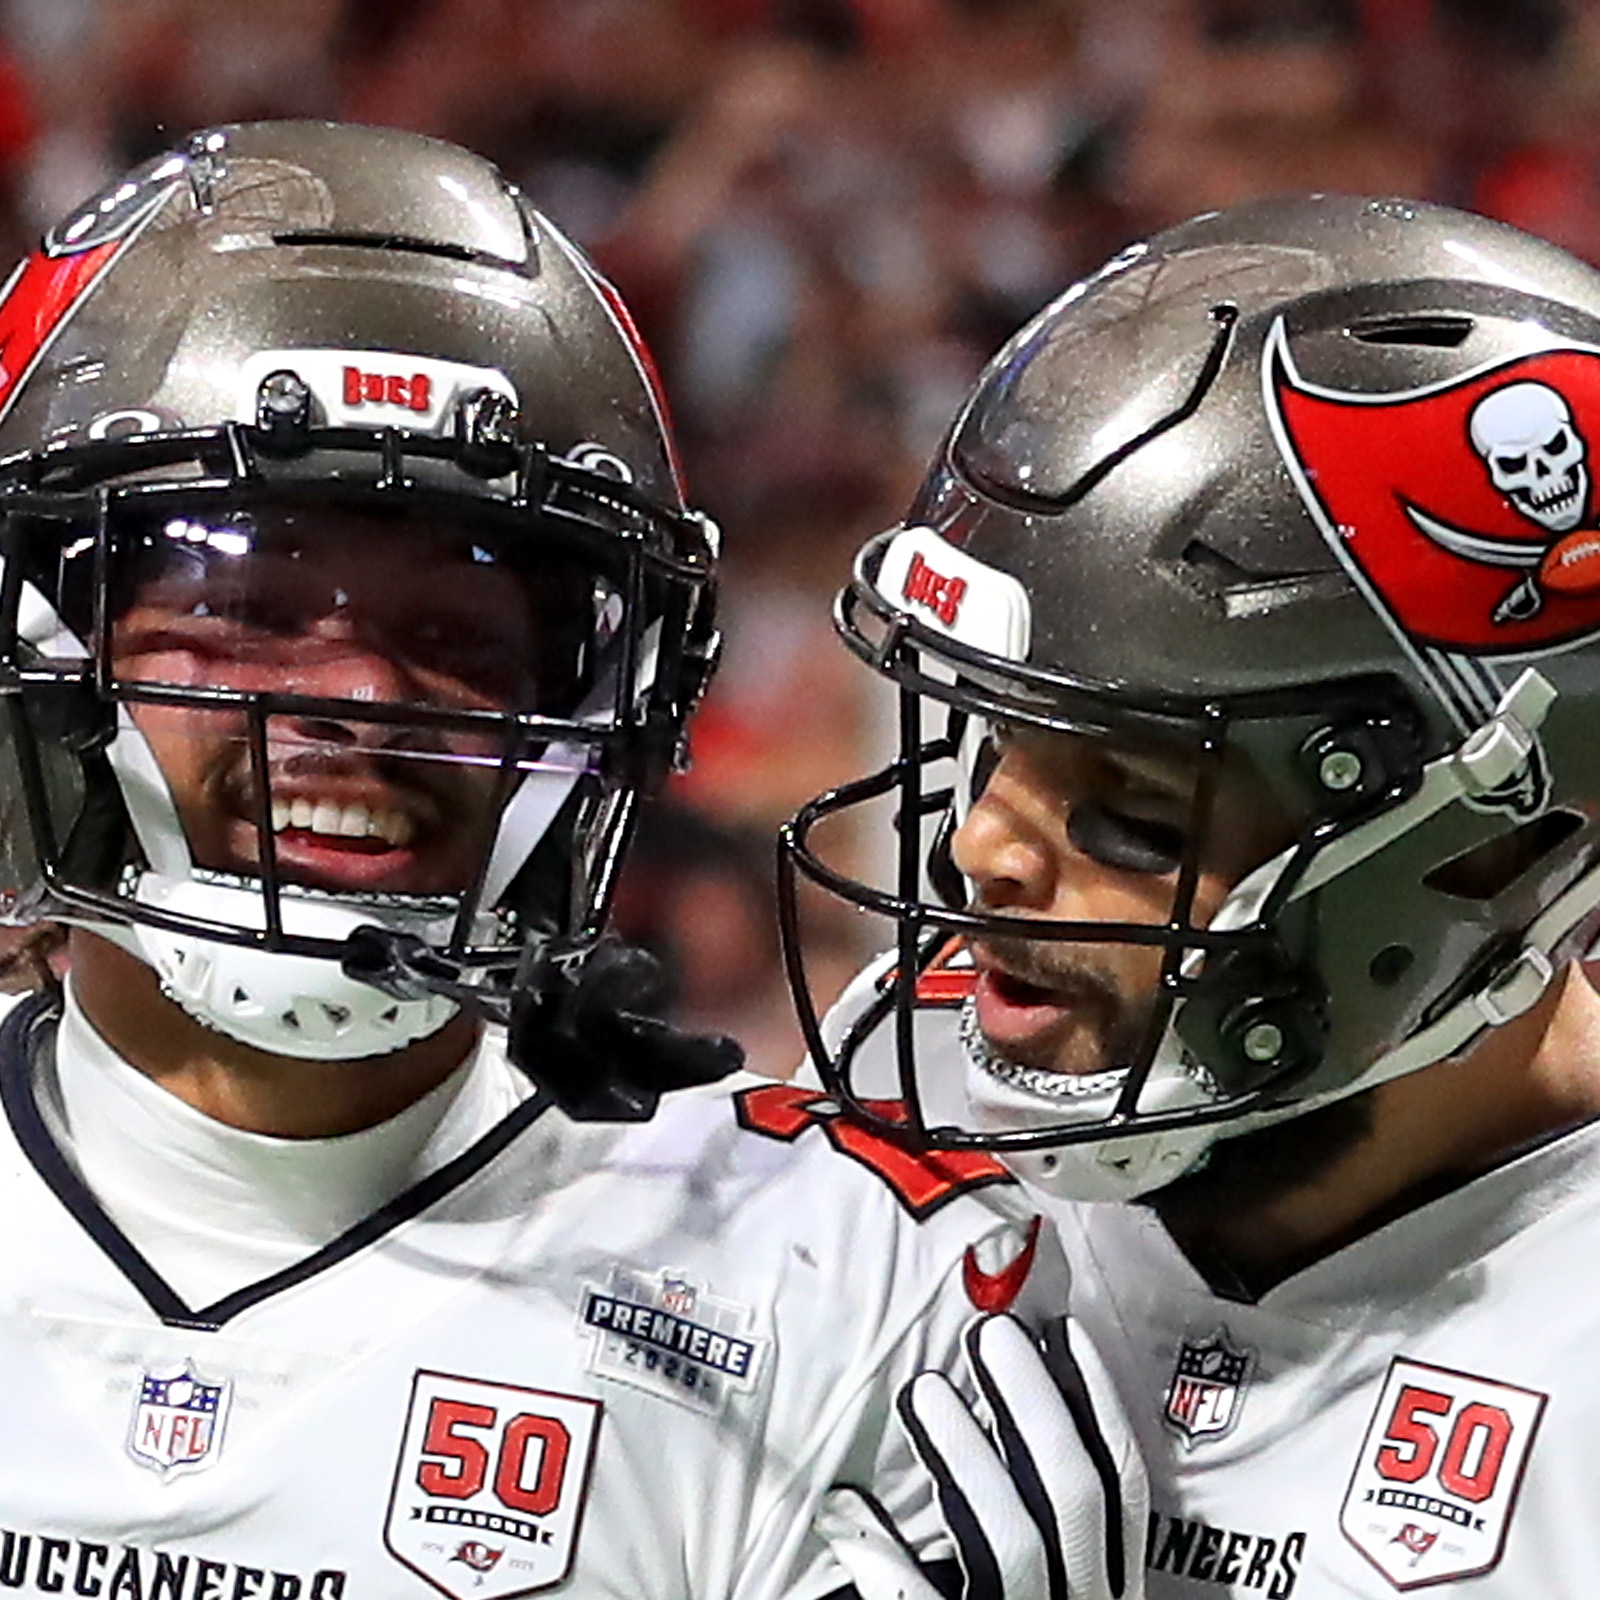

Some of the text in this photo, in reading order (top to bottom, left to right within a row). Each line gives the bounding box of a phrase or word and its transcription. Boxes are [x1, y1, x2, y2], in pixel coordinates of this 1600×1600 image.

[141, 1411, 206, 1458] NFL
[1173, 1379, 1225, 1427] NFL
[1375, 1384, 1514, 1504] 50
[416, 1397, 571, 1518] 50
